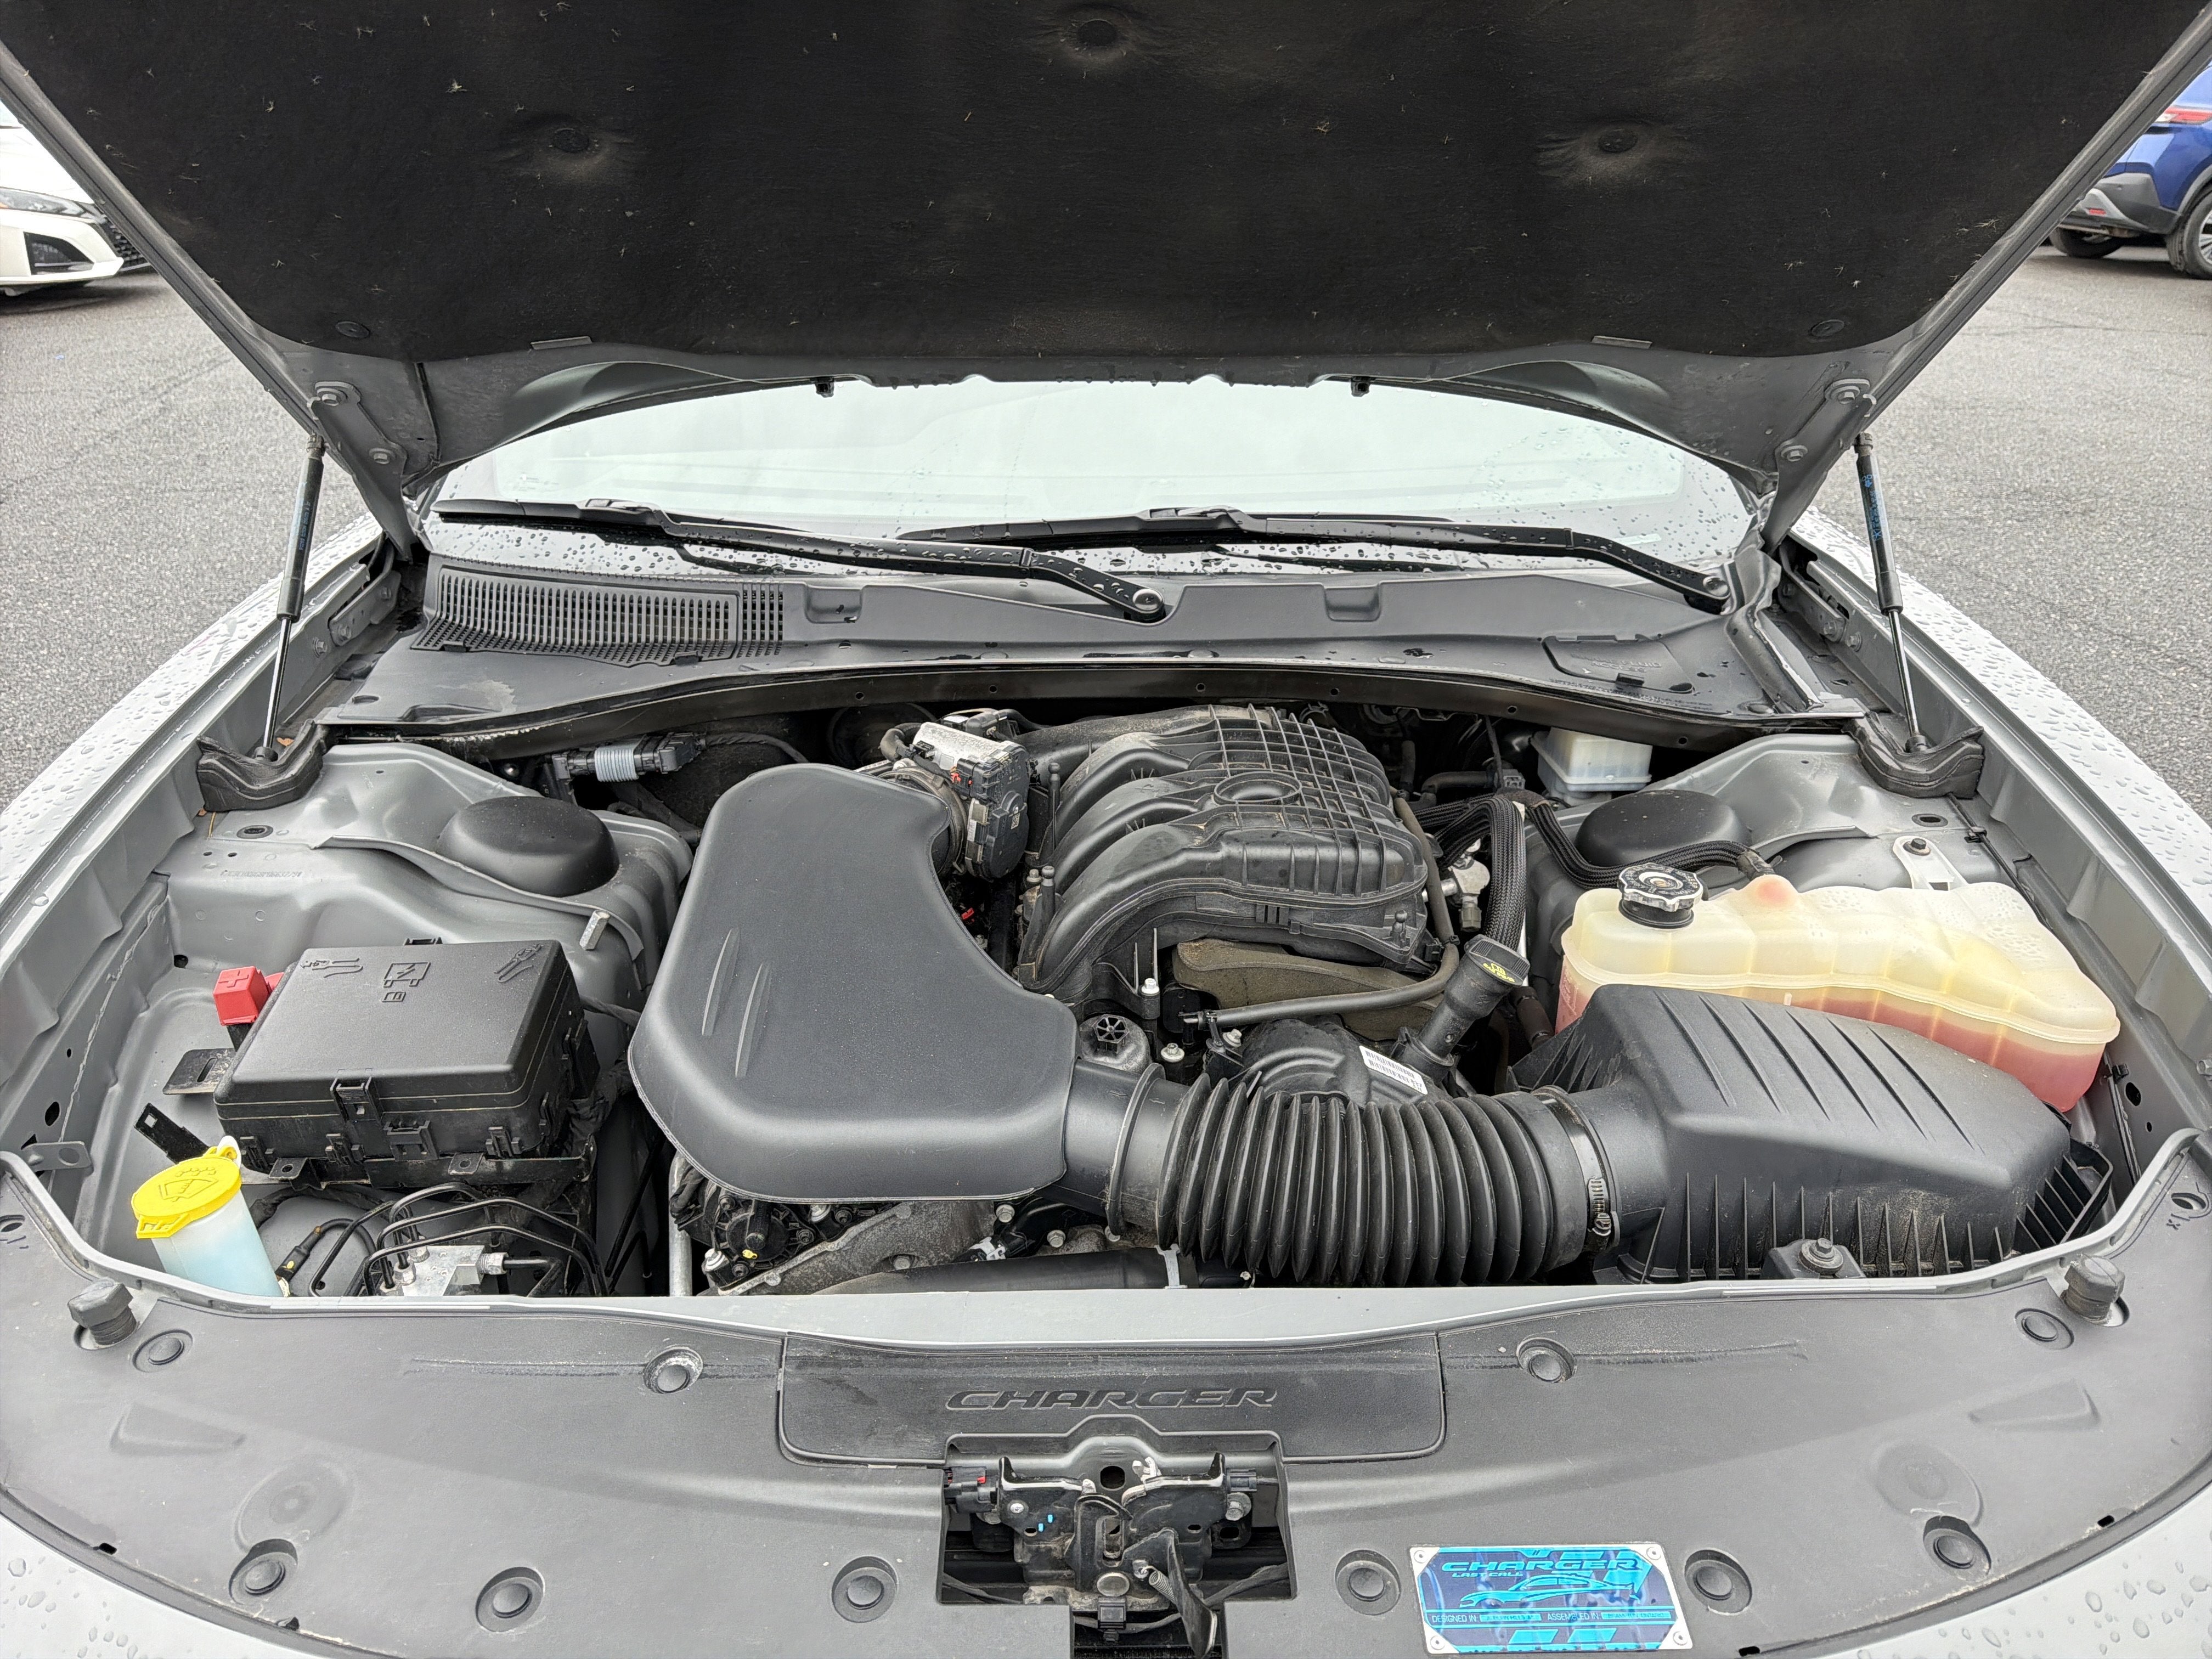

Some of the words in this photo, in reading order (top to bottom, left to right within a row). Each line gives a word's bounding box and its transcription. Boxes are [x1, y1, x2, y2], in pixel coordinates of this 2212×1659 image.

[945, 1389, 1277, 1410] CHARGER
[1442, 1559, 1641, 1571] CHARGER
[1431, 1615, 1468, 1623] DESIGNED
[1547, 1612, 1590, 1621] ASSEMBLED
